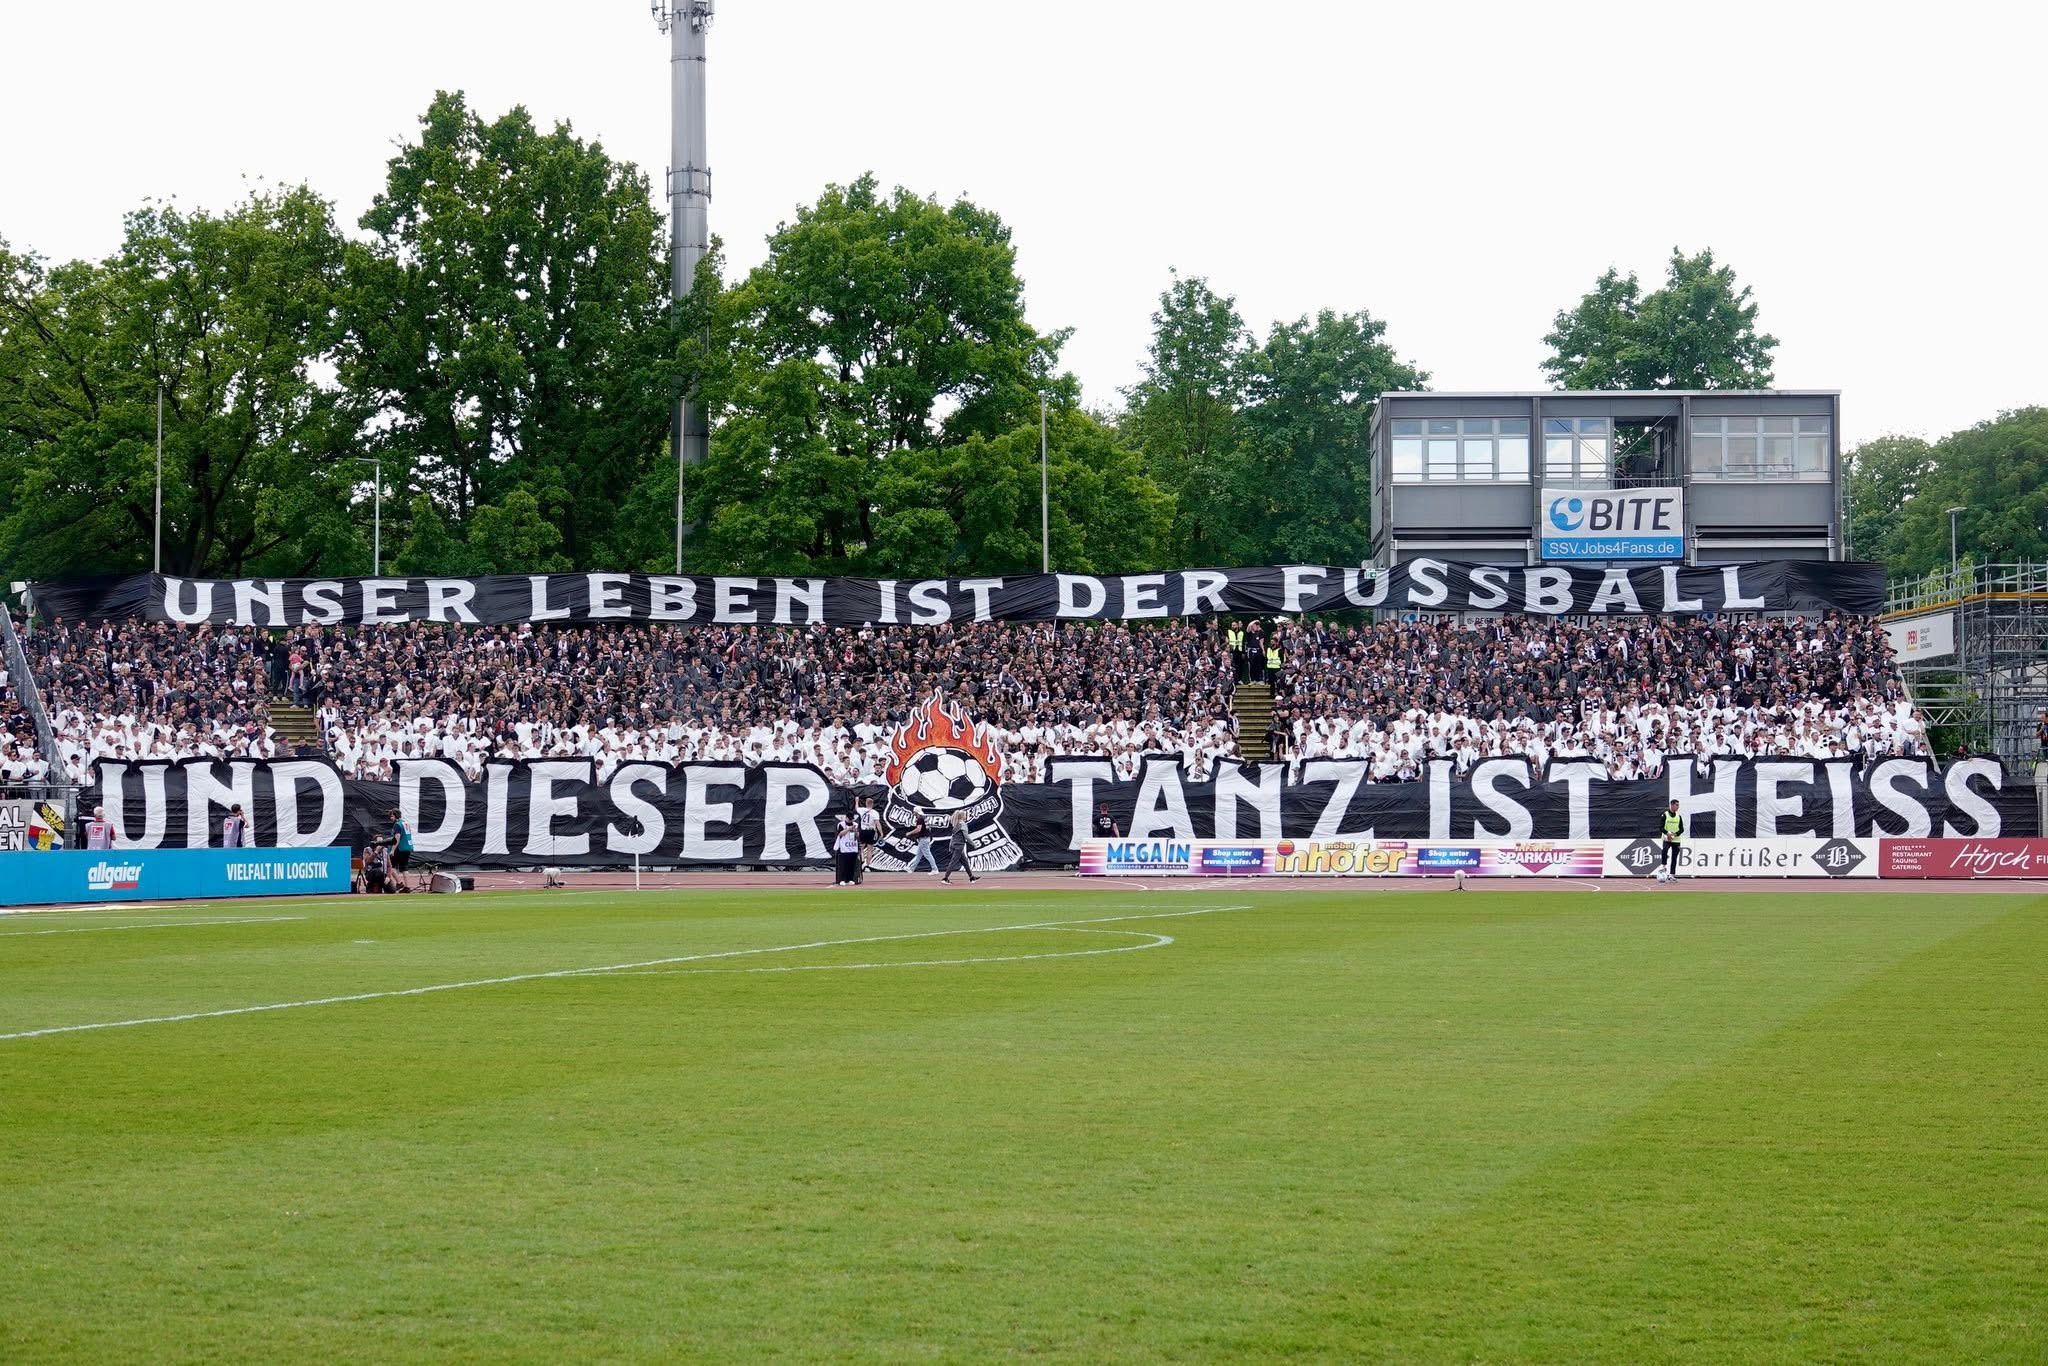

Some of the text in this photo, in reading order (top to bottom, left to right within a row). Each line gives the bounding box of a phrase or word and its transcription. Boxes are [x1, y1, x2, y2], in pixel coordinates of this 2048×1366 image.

[1589, 499, 1674, 531] BITE
[1549, 541, 1675, 554] SSV.Jobs4Fans.de
[163, 557, 1766, 627] UNSER LEBEN IST DER FUSSBALL
[99, 757, 2004, 861] UND DIESER TANZ IST HEISS
[889, 805, 912, 827] WIR
[1107, 843, 1191, 863] MEGA IN
[1212, 850, 1231, 858] Shop
[1275, 840, 1408, 873] inhofer
[1427, 850, 1447, 858] Shop
[1498, 851, 1573, 864] SPARKAUF
[1679, 846, 1803, 867] Barfüßer
[1950, 843, 2030, 874] Hirsch
[88, 861, 142, 886] allgaier
[226, 861, 329, 881] VIELFALT IN LOGISTIK
